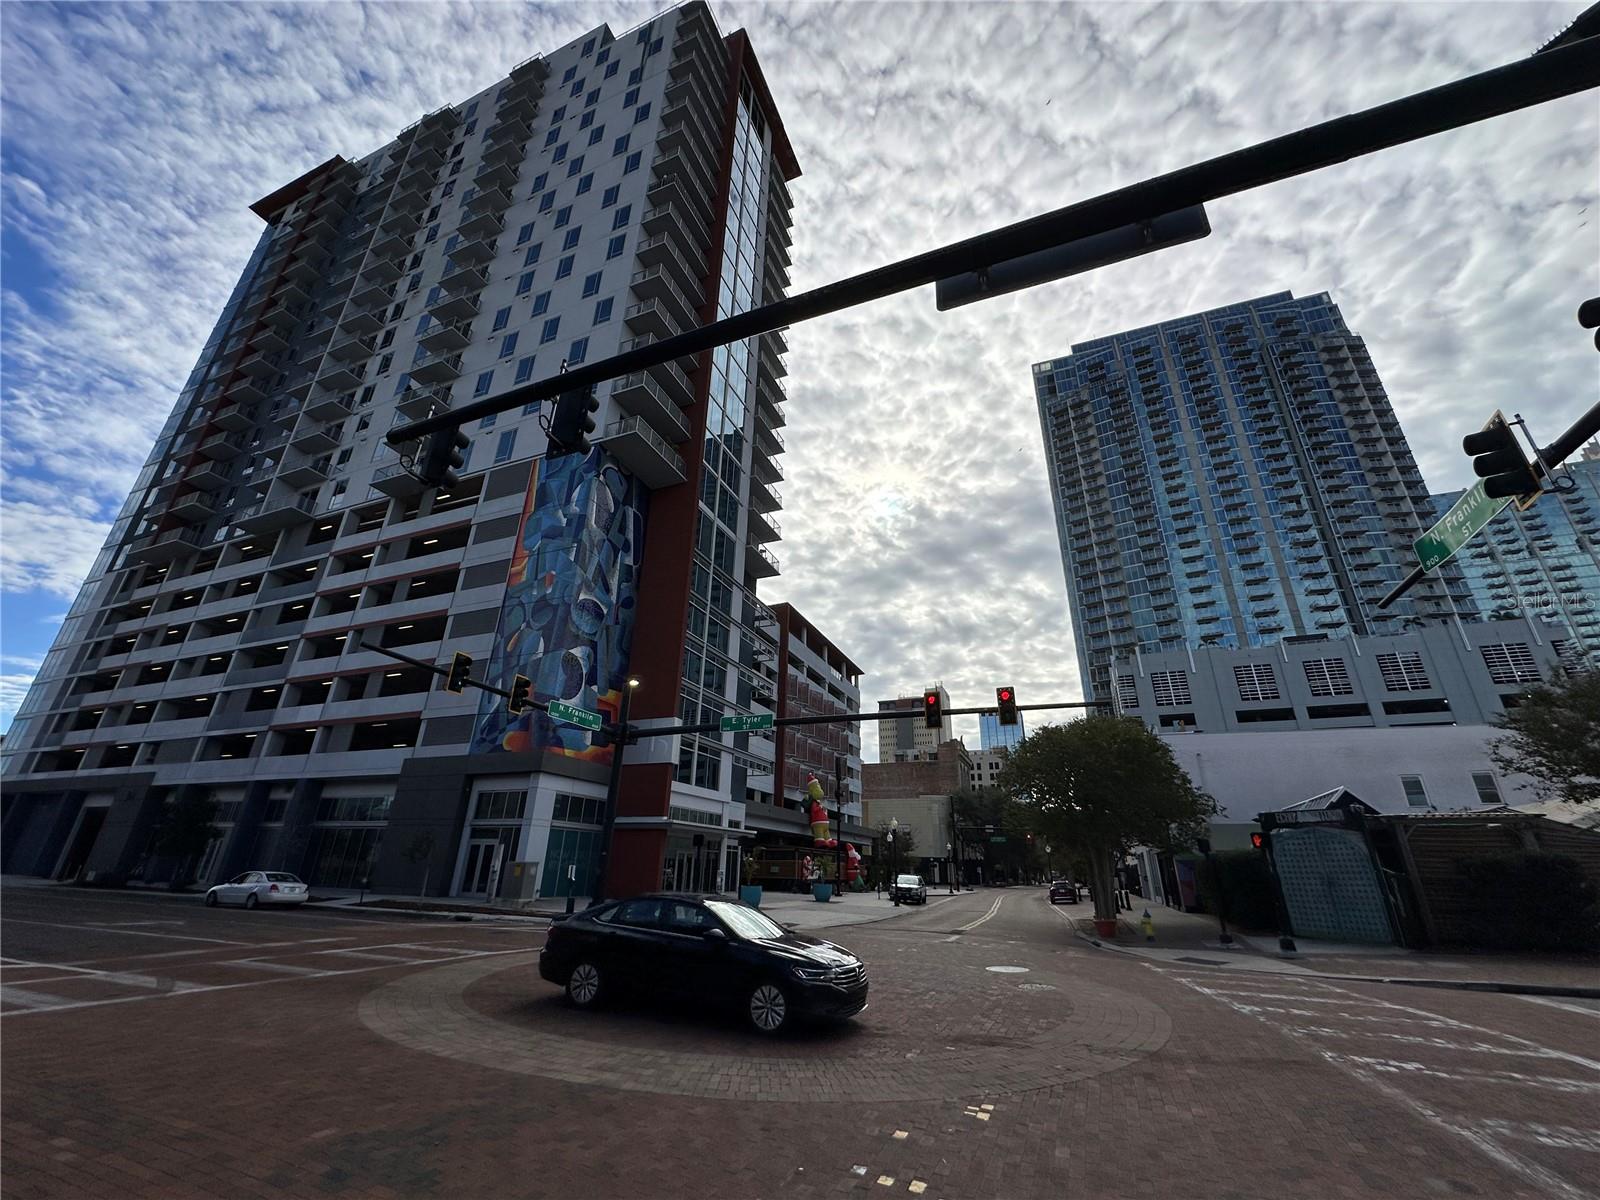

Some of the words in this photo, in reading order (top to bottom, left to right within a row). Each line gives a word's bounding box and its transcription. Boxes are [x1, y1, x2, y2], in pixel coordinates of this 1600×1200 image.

[1430, 529, 1445, 545] N.
[1445, 485, 1486, 532] Frankli
[1461, 520, 1474, 537] ST
[1425, 554, 1440, 568] 900
[568, 707, 594, 721] Franklin
[742, 716, 762, 725] Tyler
